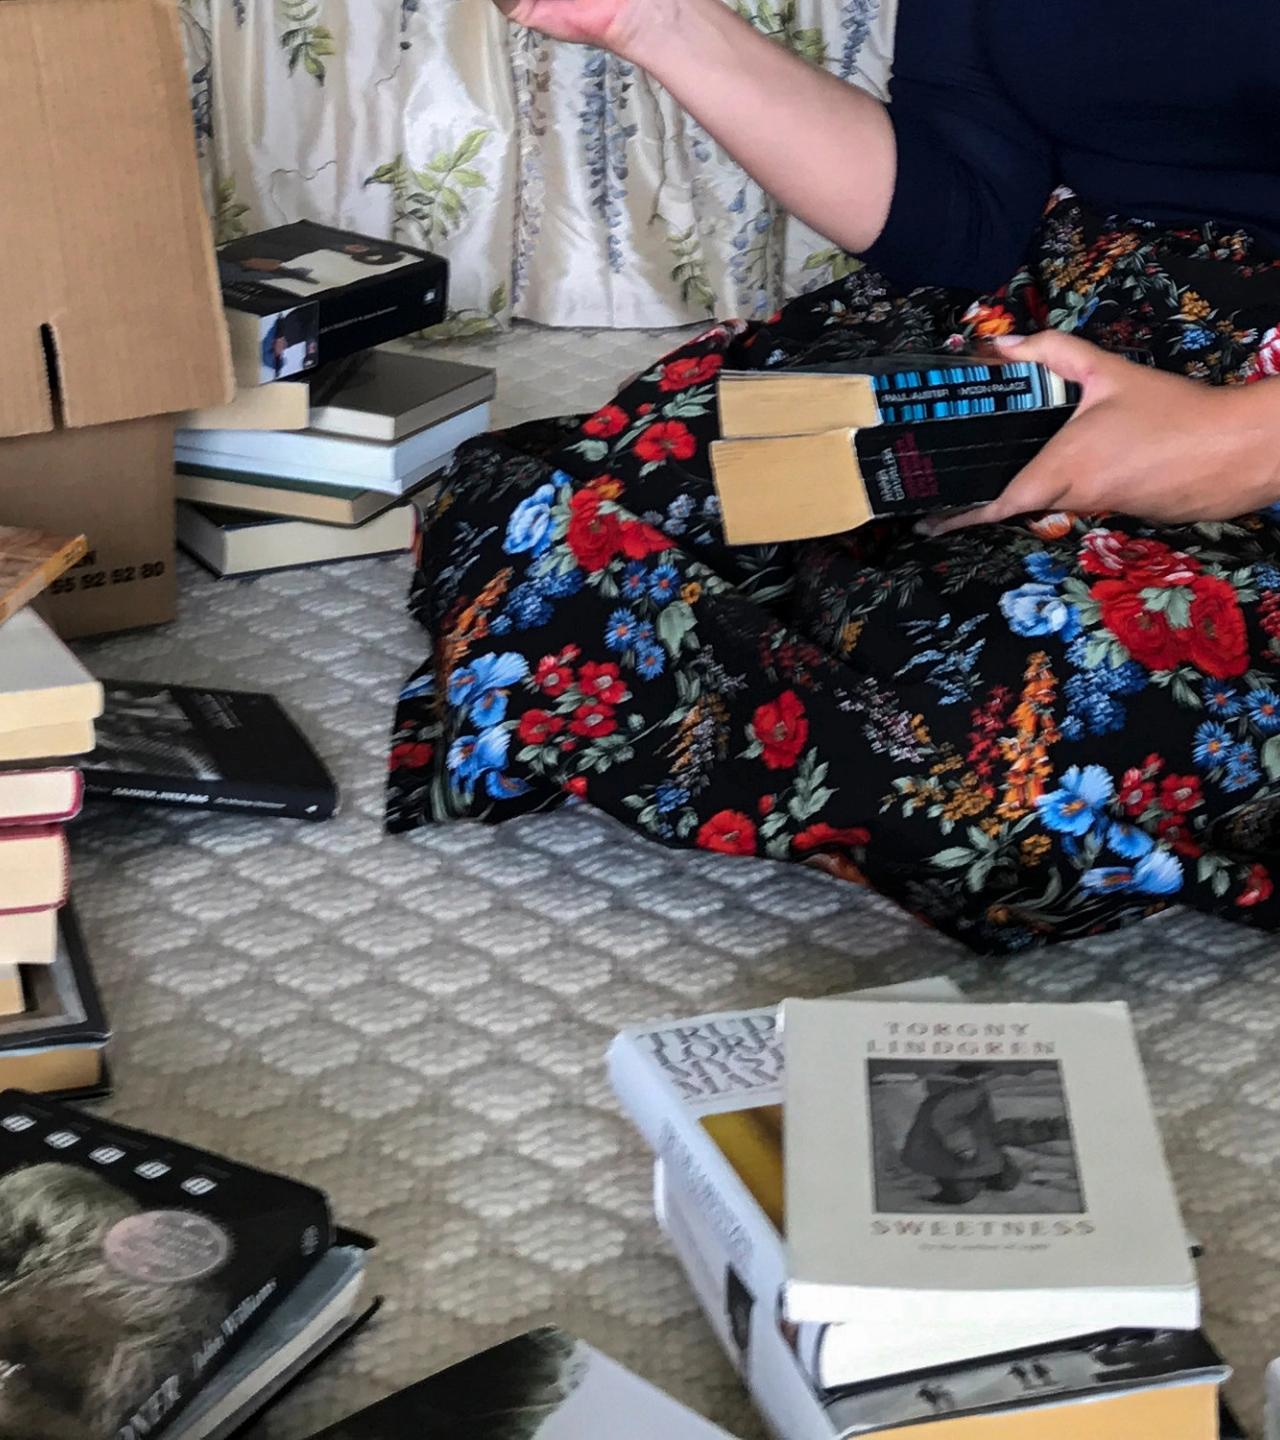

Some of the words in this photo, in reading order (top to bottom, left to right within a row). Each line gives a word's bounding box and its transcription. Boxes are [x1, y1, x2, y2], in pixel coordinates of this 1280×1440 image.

[883, 391, 911, 403] PAUL
[911, 389, 950, 401] AUSTER
[990, 381, 1027, 394] PALACE
[885, 1021, 1031, 1037] TORGNY
[866, 1040, 1057, 1056] LINDGREN
[871, 1220, 1097, 1238] SWEETNESS
